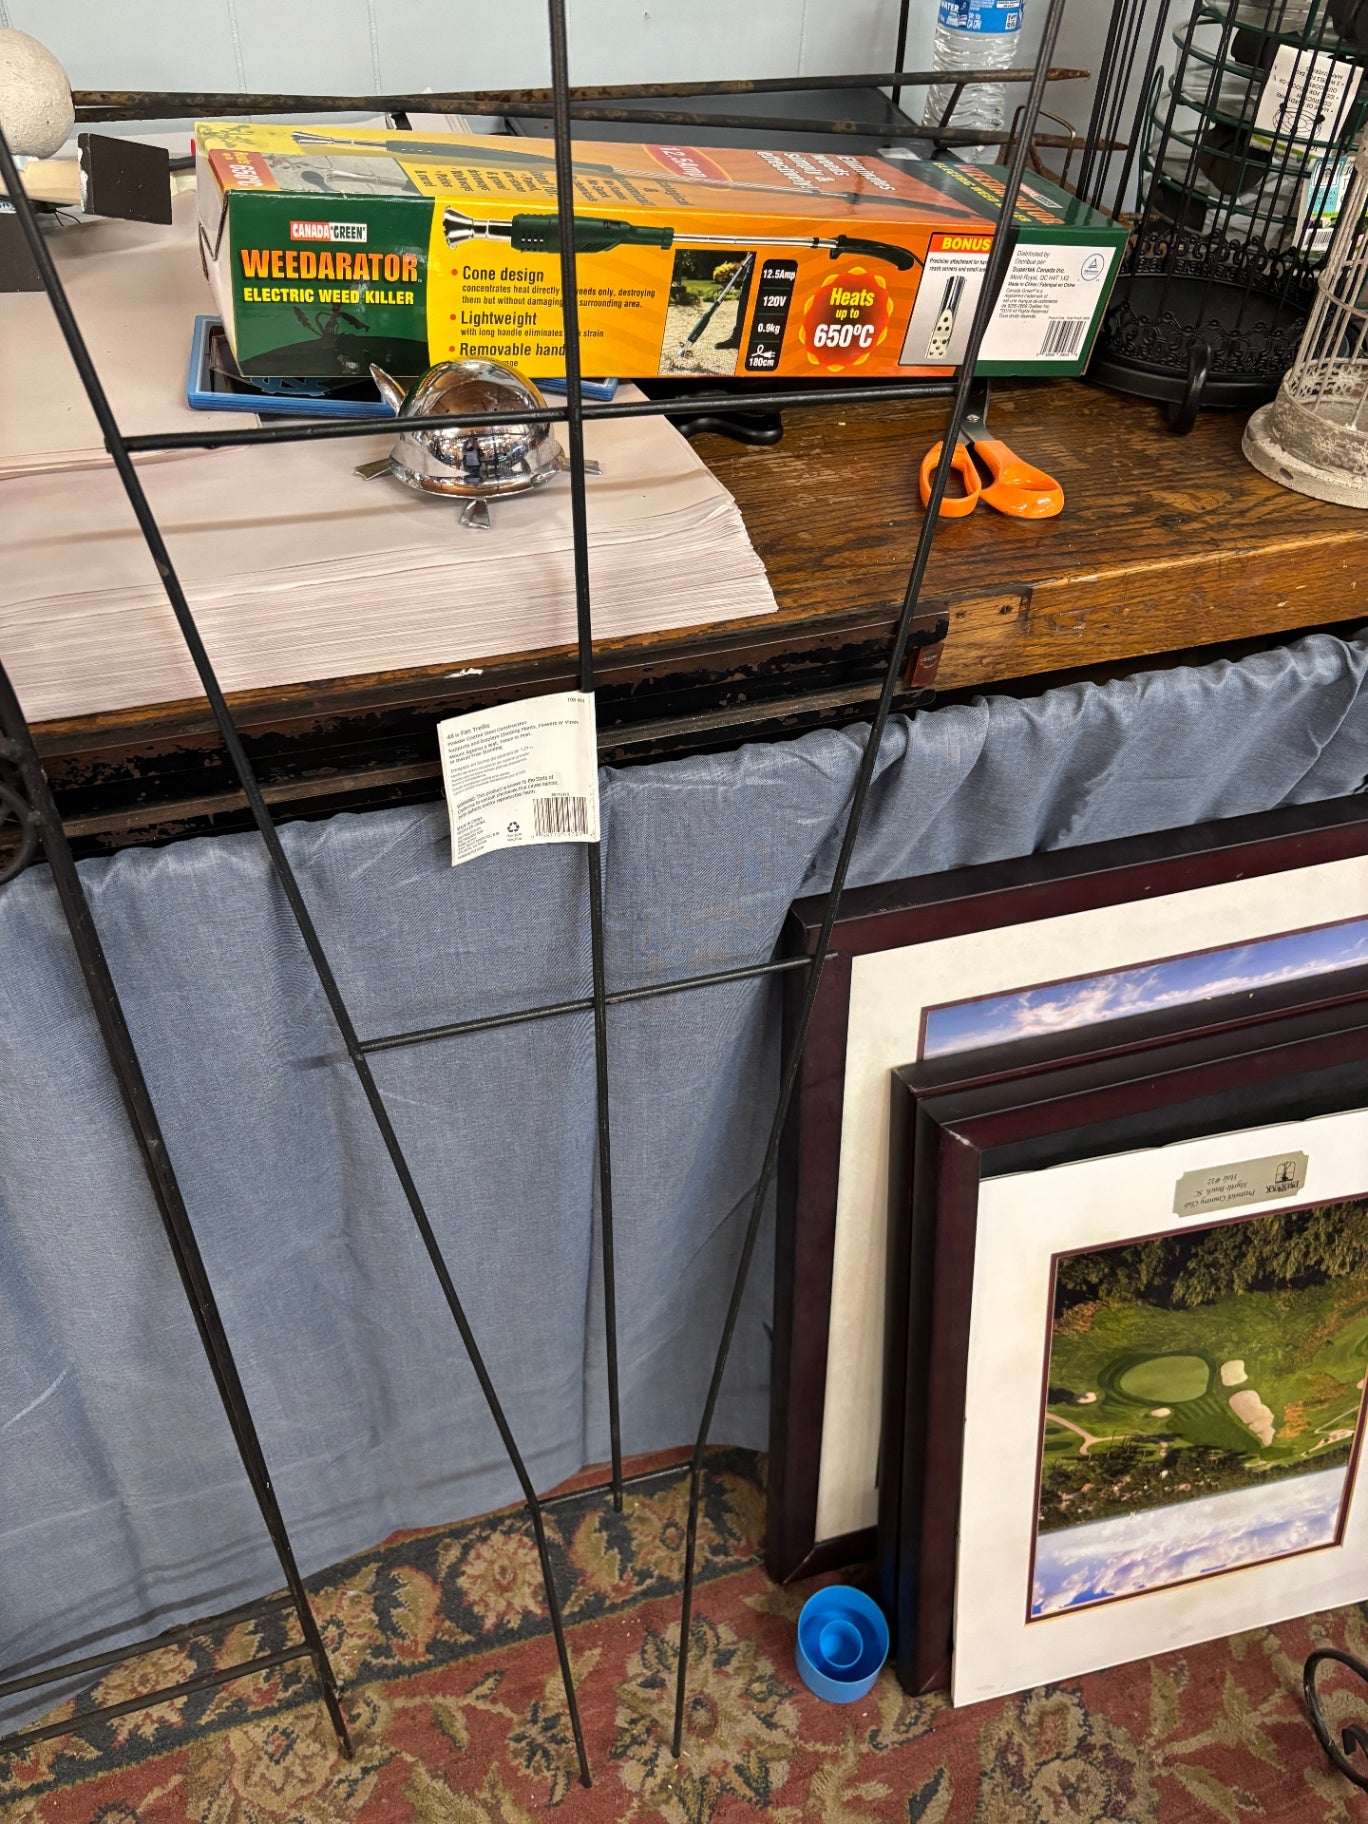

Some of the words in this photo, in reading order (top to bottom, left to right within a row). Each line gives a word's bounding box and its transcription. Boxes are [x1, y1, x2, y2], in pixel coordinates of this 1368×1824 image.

[836, 156, 896, 190] Eliminates
[292, 224, 330, 238] CANADA
[332, 226, 363, 240] GREEN
[942, 237, 992, 251] BONUS
[240, 250, 418, 282] WEEDARATOR
[463, 266, 496, 280] Cone
[500, 268, 544, 284] design
[764, 269, 795, 280] 12.5Amp
[244, 288, 314, 302] ELECTRIC
[318, 289, 360, 304] WEED
[366, 291, 414, 304] KILLER
[462, 284, 511, 294] concentrates
[514, 286, 530, 294] heat
[532, 286, 560, 296] directly
[598, 288, 616, 297] only,
[618, 288, 656, 298] destroying
[830, 288, 874, 306] Heats
[462, 295, 482, 304] them
[484, 296, 496, 304] but
[497, 296, 526, 305] without
[527, 298, 564, 308] damaging
[579, 300, 622, 308] surrounding
[764, 296, 787, 306] 120V
[461, 311, 537, 328] Lightweight
[836, 308, 846, 320] up
[850, 308, 860, 318] to
[460, 328, 476, 336] with
[478, 328, 494, 338] long
[497, 328, 522, 336] handle
[524, 329, 563, 337] eliminates
[758, 323, 780, 334] 0.9kg
[460, 343, 530, 356] Removable
[536, 344, 566, 356] hand
[750, 358, 774, 366] 180cm
[460, 728, 471, 736] Fan
[472, 724, 490, 732] Trellis
[466, 733, 483, 741] Coated
[1201, 1194, 1226, 1204] Country
